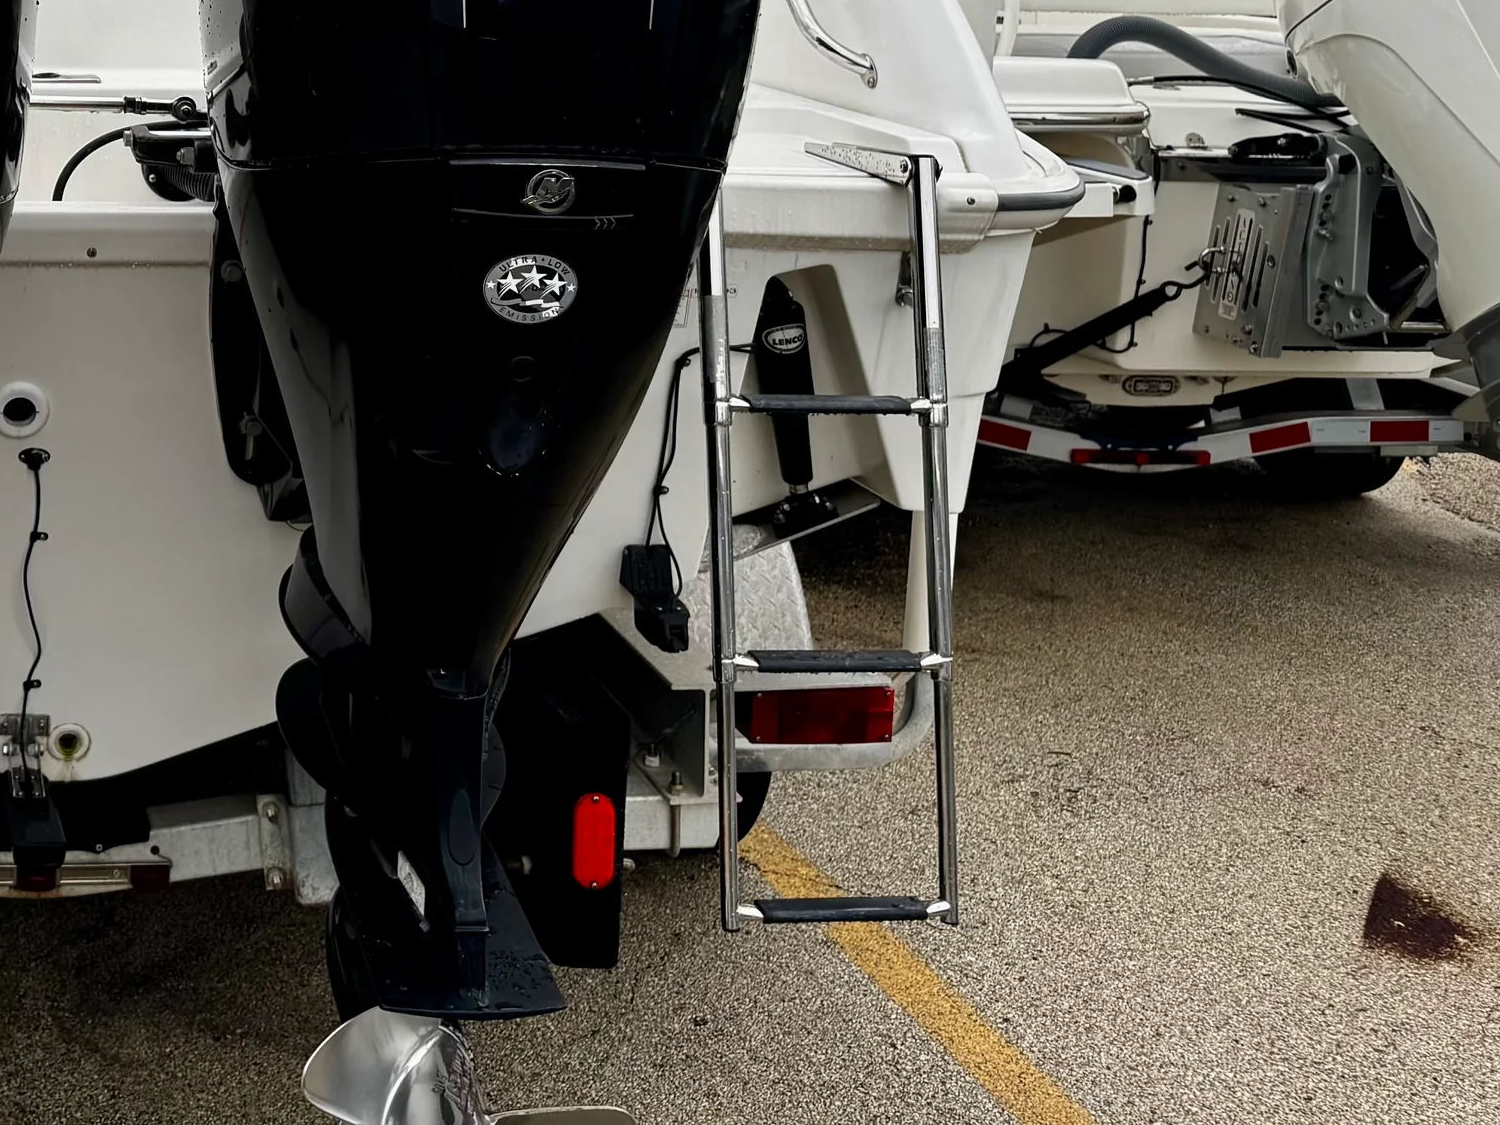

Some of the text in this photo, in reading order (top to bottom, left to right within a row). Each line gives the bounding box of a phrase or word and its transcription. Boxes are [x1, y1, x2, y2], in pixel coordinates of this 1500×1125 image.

[499, 256, 571, 275] ULTRA LOW
[500, 306, 560, 322] EMISSION
[772, 333, 803, 346] LENCO
